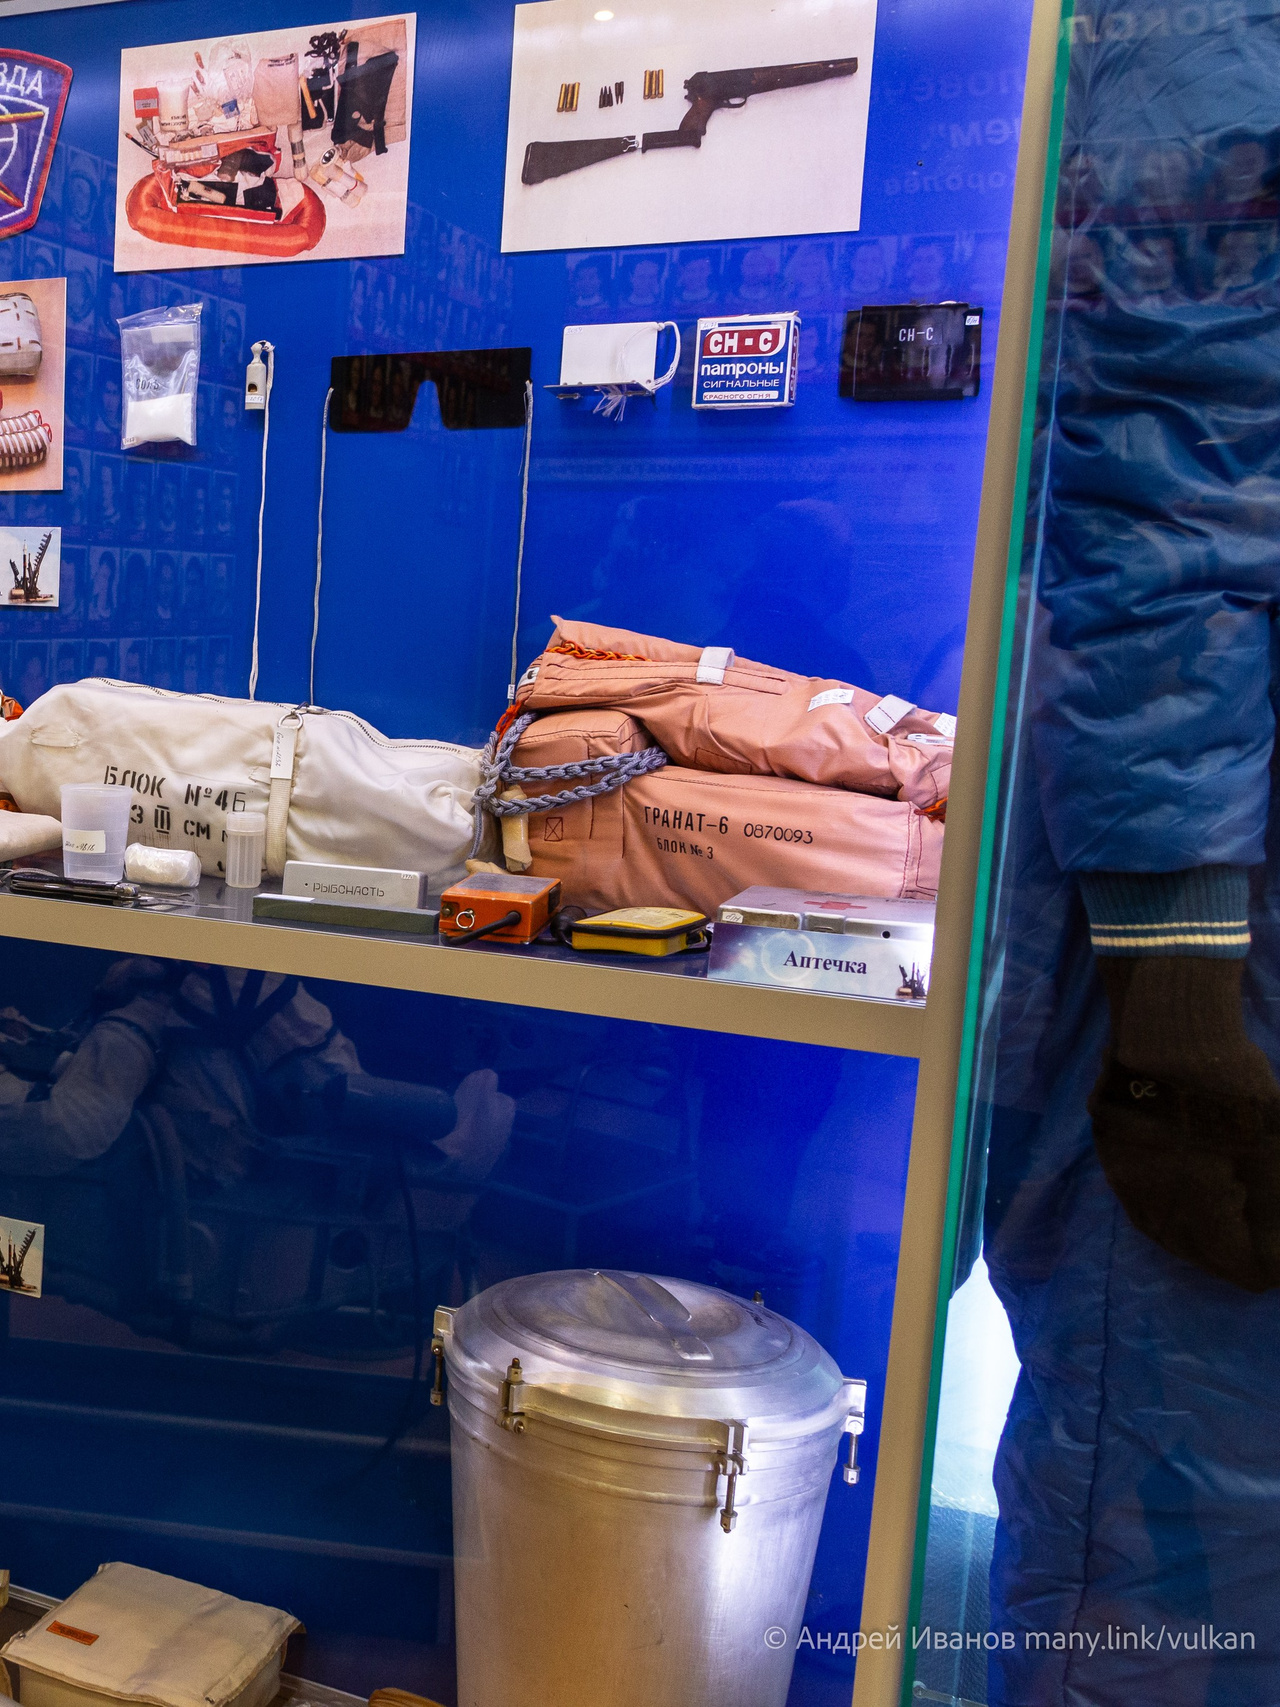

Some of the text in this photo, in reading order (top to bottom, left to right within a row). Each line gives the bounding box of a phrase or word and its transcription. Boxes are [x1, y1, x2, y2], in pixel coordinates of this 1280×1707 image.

[701, 362, 784, 379] патроны
[703, 379, 779, 388] СИГНАЛЬНЫЕ
[104, 765, 167, 799] БЛОК
[644, 806, 813, 845] ГРАНАТ-6 0870093
[656, 837, 714, 860] БЛОК № 3
[312, 882, 385, 897] РЫБСНАСТЬ
[783, 951, 867, 975] Аптечка
